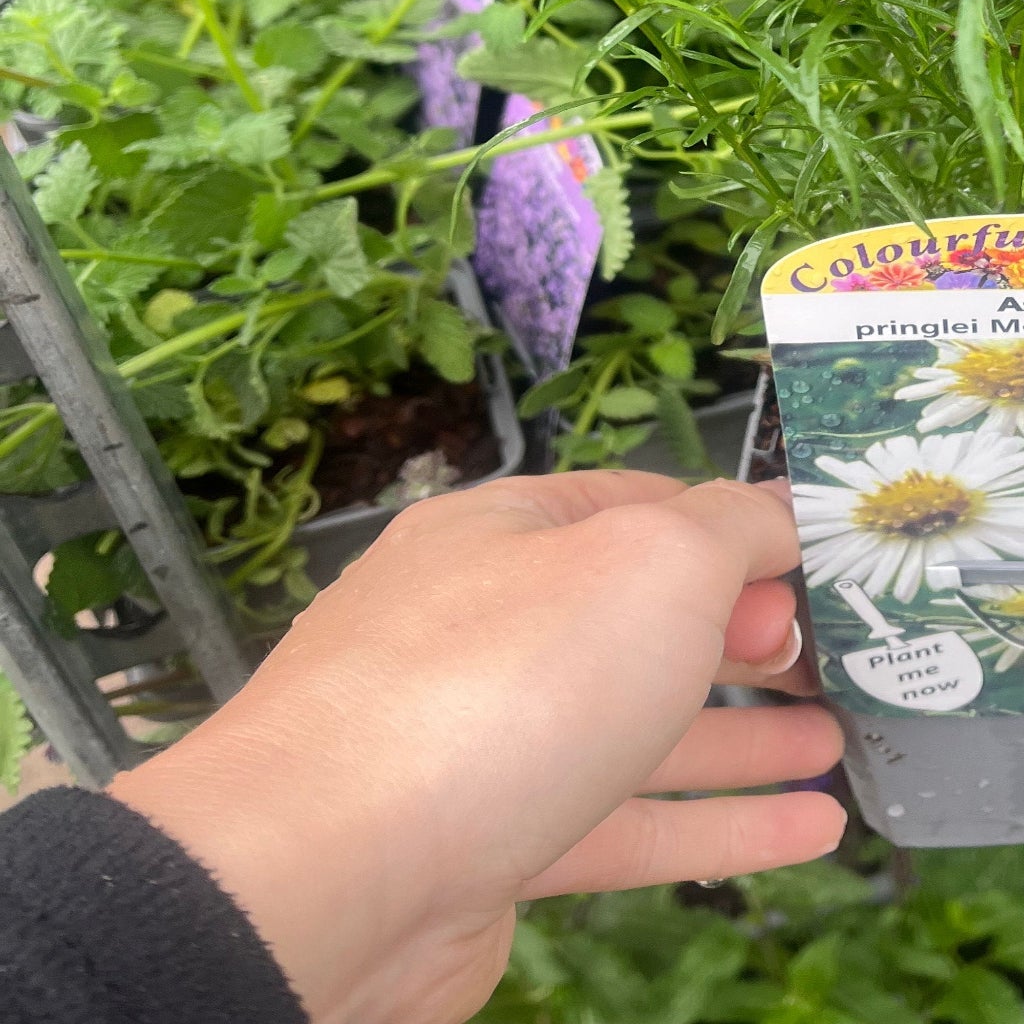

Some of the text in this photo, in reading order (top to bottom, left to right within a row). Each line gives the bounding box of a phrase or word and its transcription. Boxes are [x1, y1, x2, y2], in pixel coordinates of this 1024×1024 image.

[856, 318, 978, 339] pringlei
[868, 643, 943, 669] Plant
[898, 666, 939, 682] me
[902, 679, 959, 700] now
